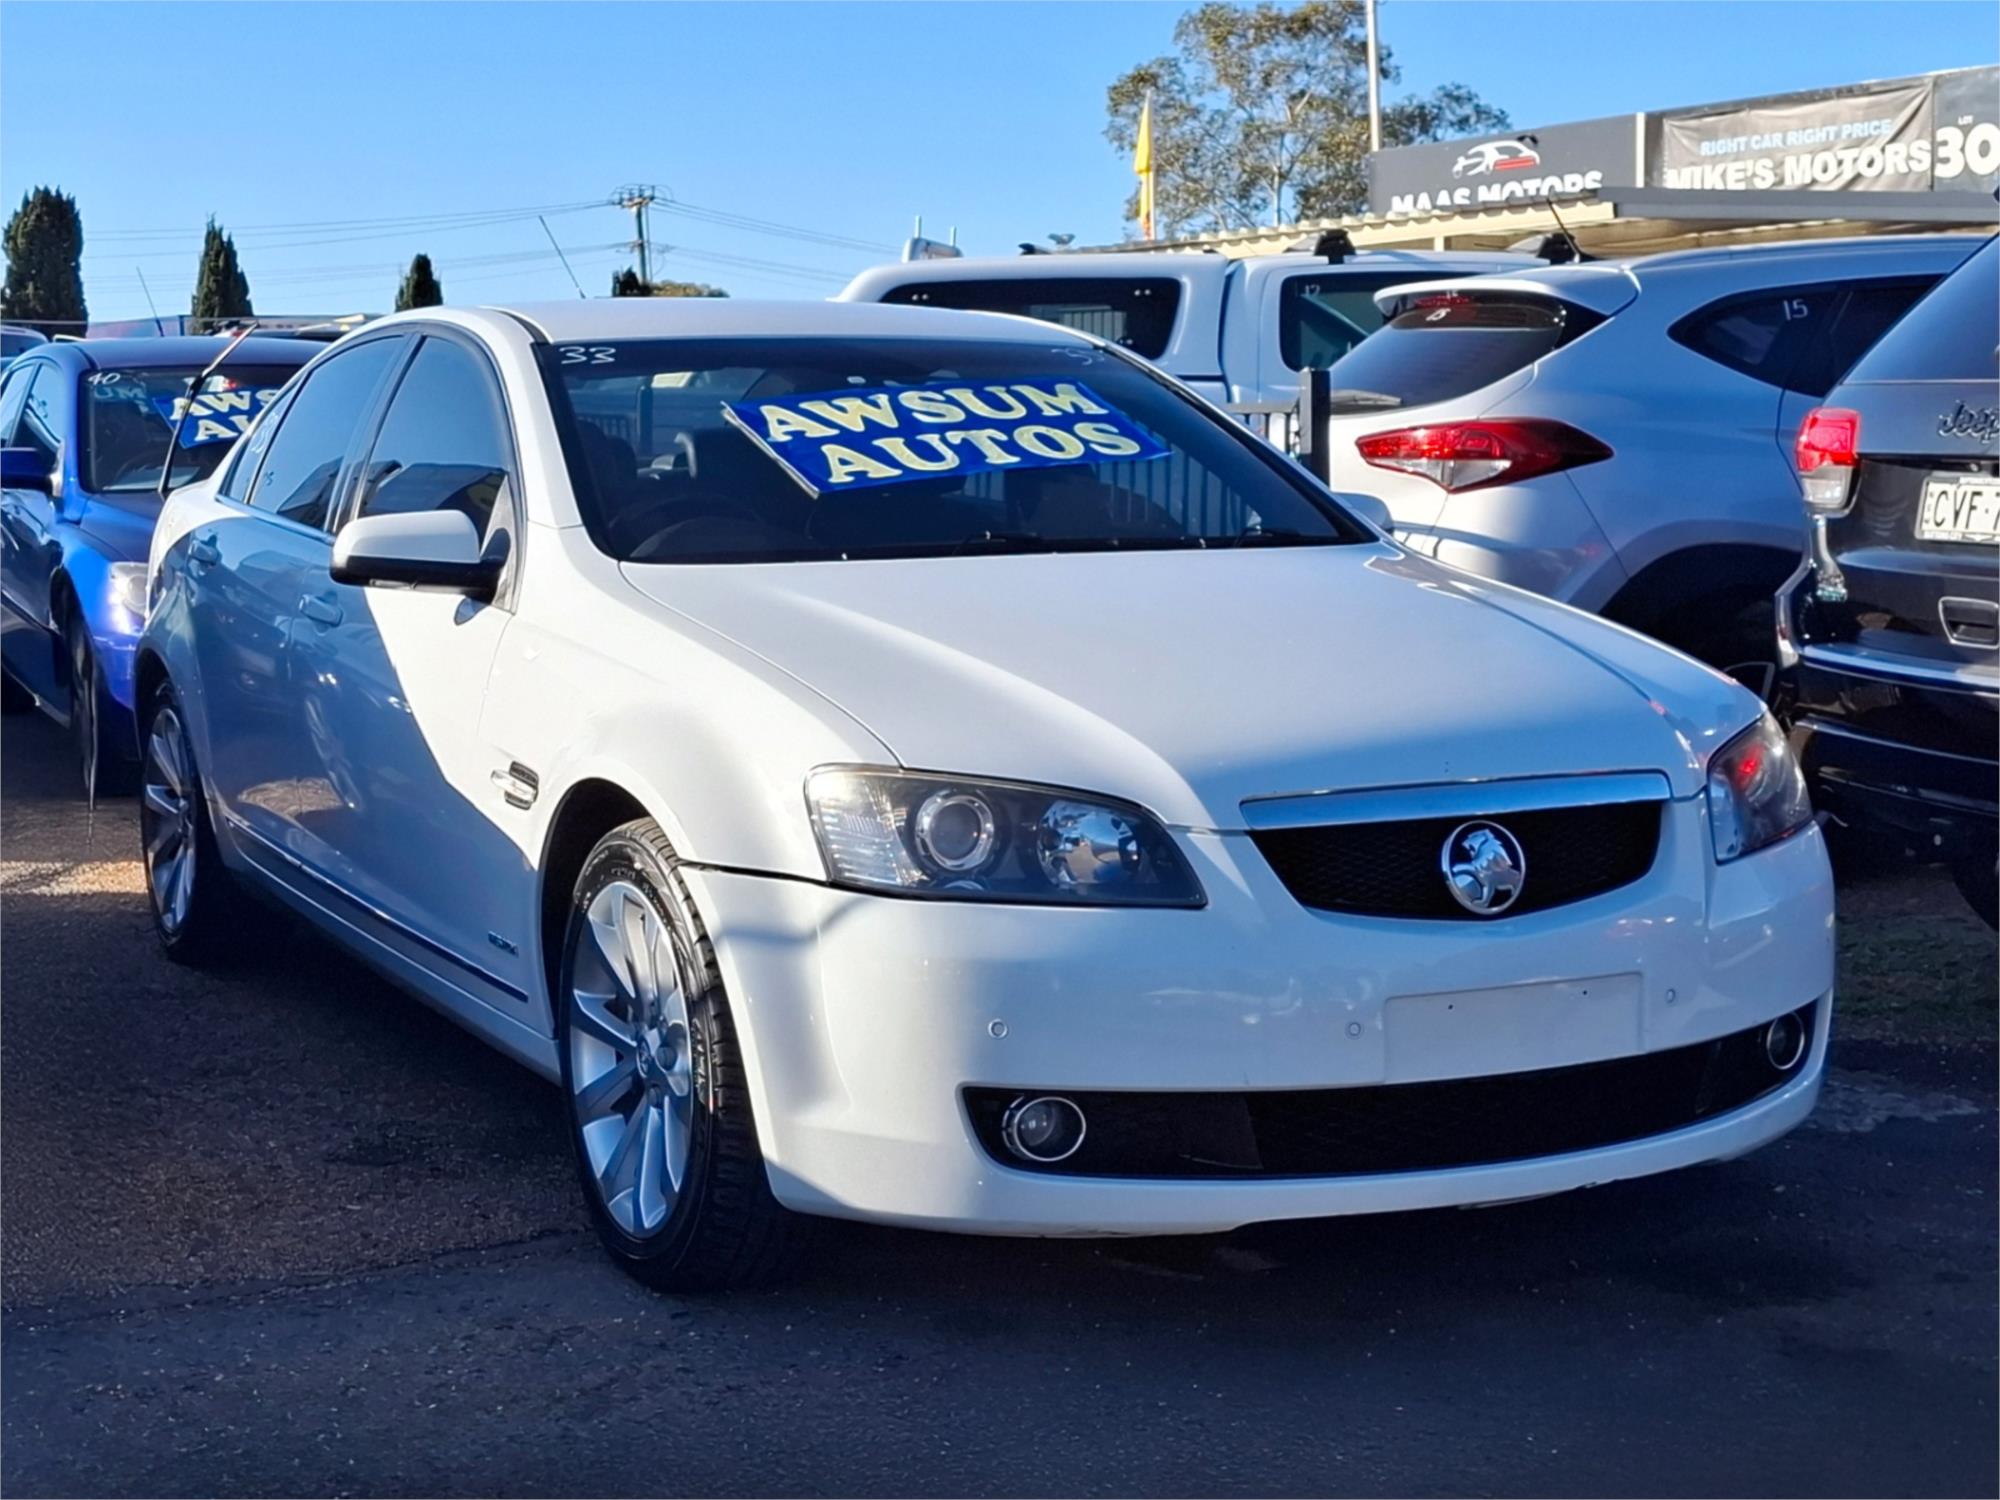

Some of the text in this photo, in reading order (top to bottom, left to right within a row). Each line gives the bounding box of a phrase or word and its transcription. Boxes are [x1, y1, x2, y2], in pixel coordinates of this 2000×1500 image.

[1700, 119, 1892, 156] RIGHT CAR RIGHT PRICE
[1665, 139, 1932, 190] MIKE'S MOTORS
[1391, 171, 1603, 212] MAAS MOTORS
[1783, 299, 1808, 320] 15
[559, 346, 616, 364] 33
[760, 384, 1109, 442] AWSUM
[821, 422, 1141, 483] AUTOS
